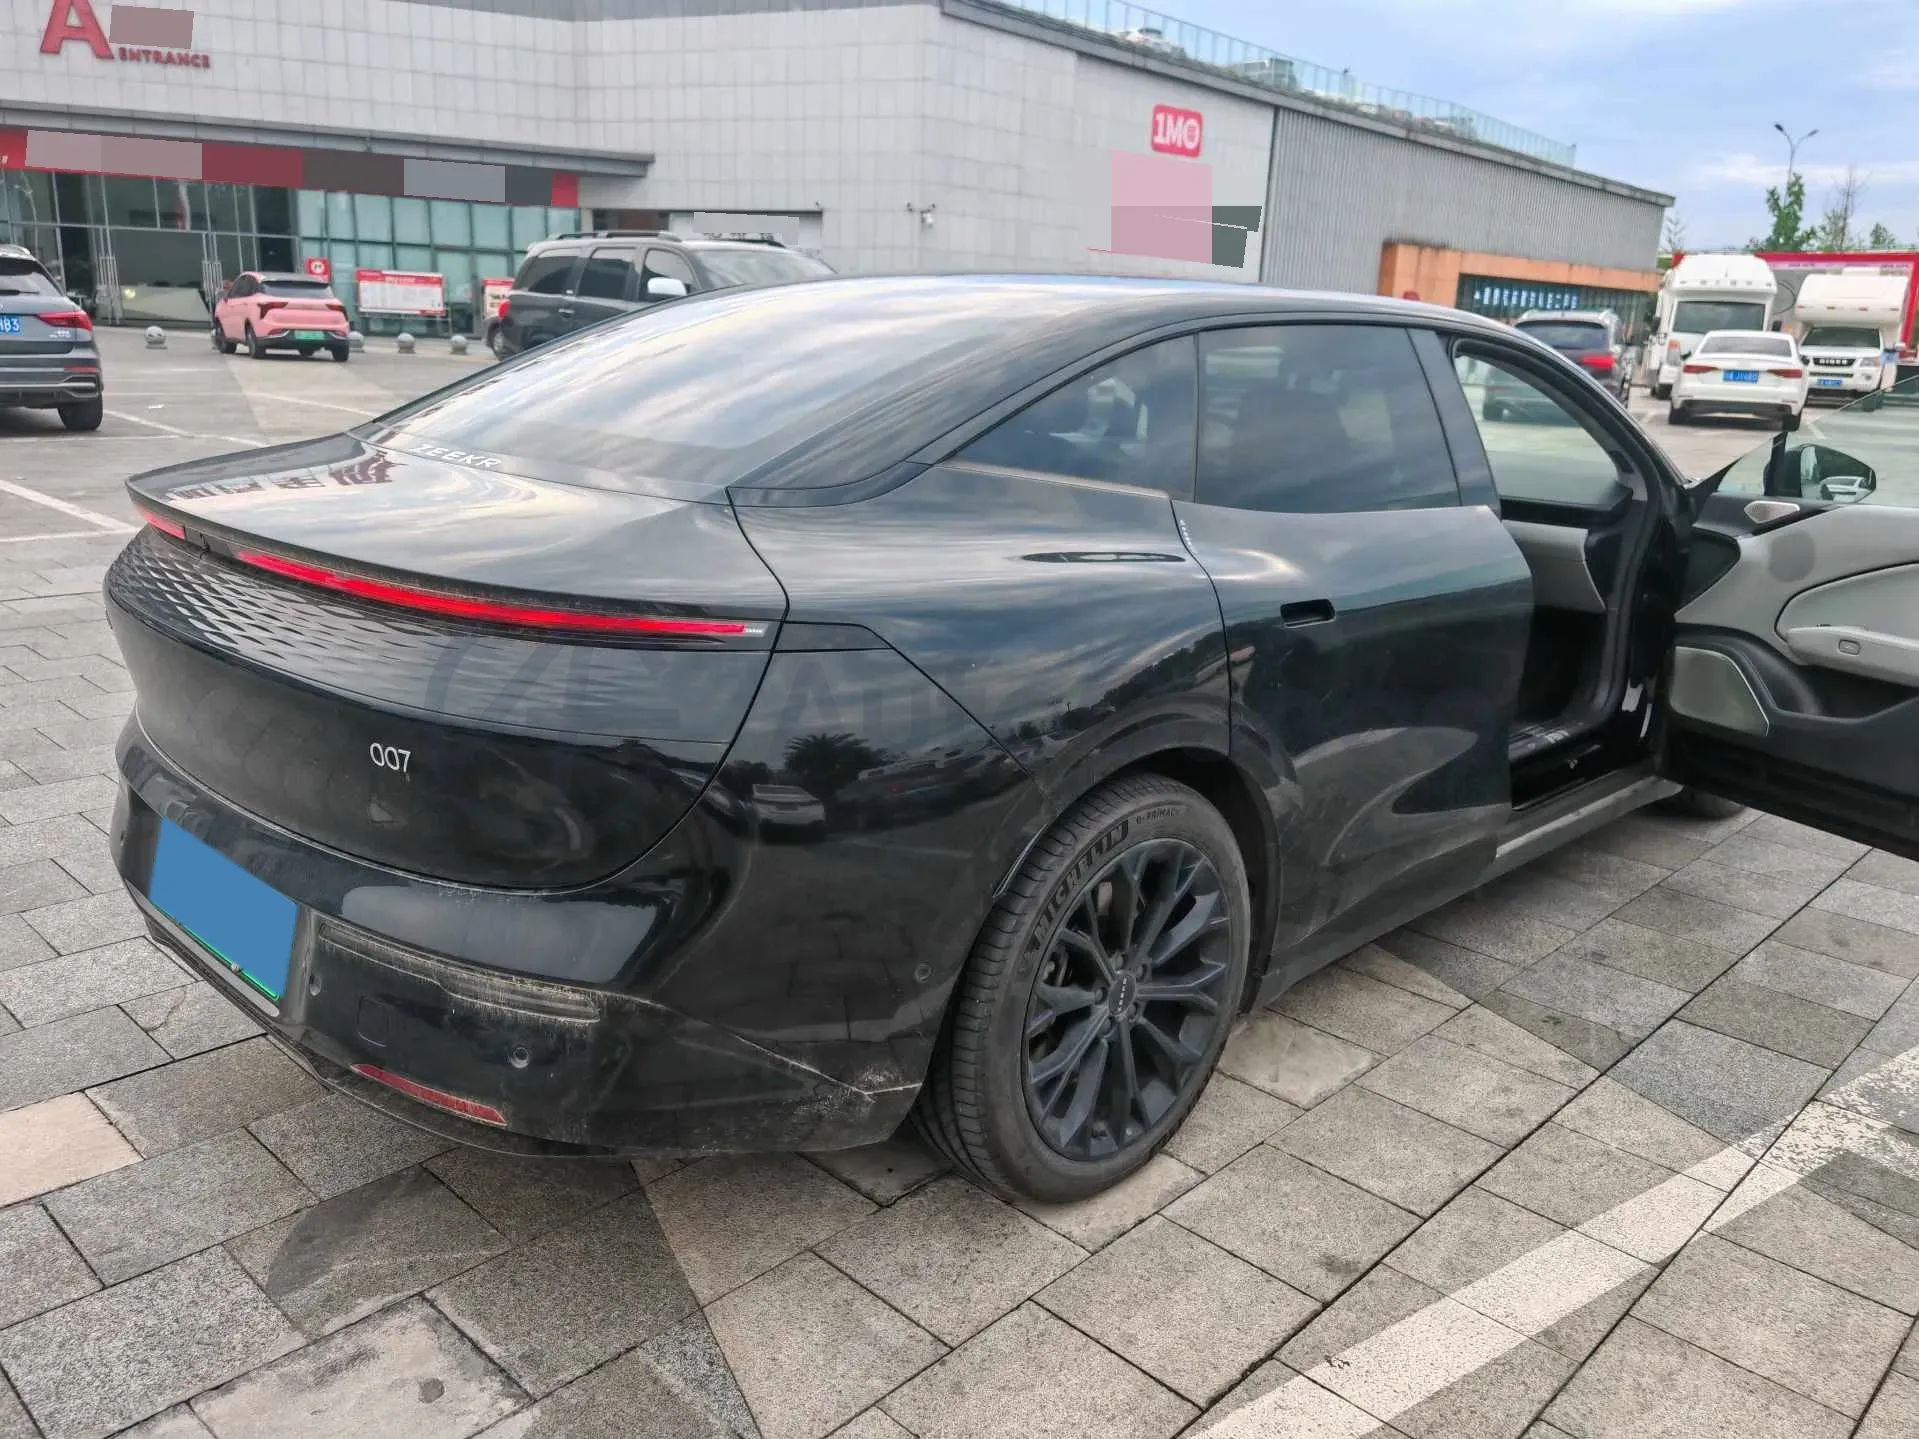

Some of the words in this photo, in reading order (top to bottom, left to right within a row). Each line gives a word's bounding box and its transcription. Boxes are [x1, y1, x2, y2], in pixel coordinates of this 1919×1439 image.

[40, 0, 114, 60] A
[118, 47, 211, 69] ENTRANCE
[369, 742, 411, 773] 007
